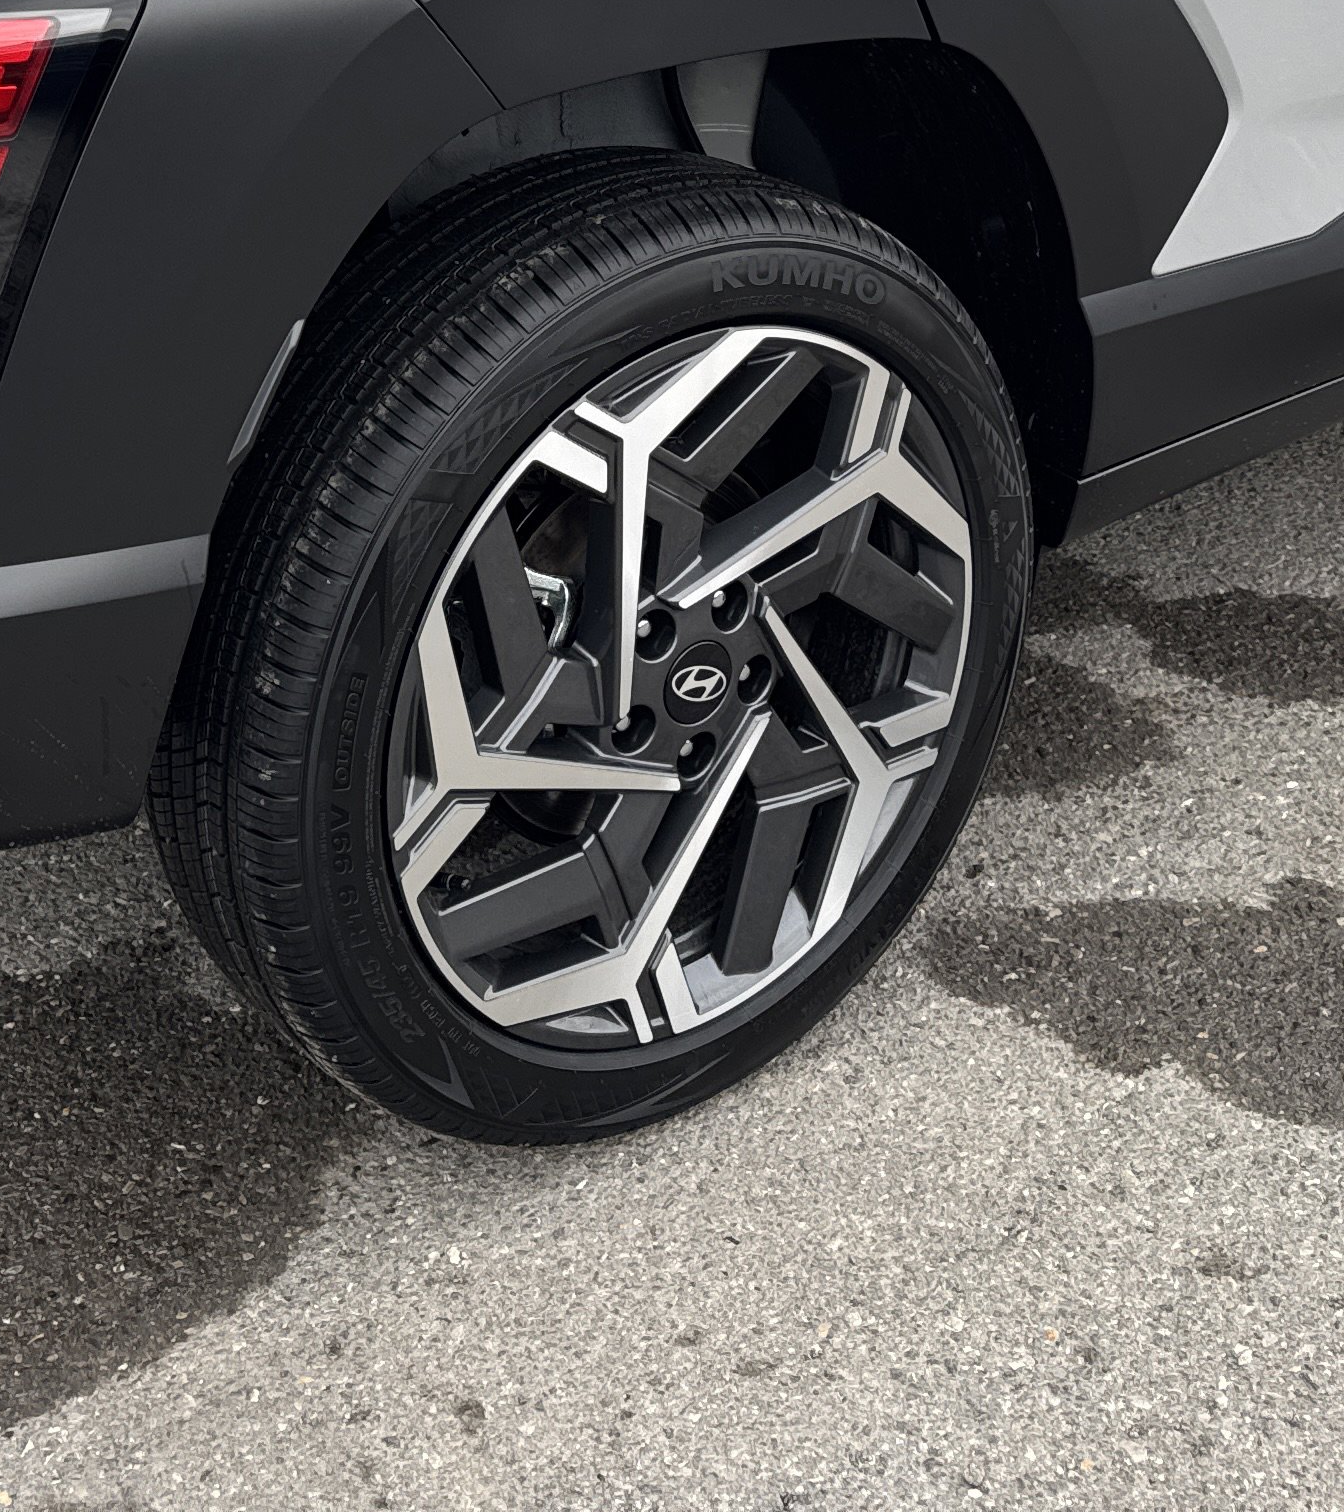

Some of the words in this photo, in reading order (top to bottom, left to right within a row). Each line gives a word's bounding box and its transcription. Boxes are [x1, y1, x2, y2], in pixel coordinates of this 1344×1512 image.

[710, 253, 888, 305] KUMHO
[334, 675, 366, 787] OUTSIDE
[329, 802, 355, 875] 99V
[356, 958, 427, 1044] 235/45
